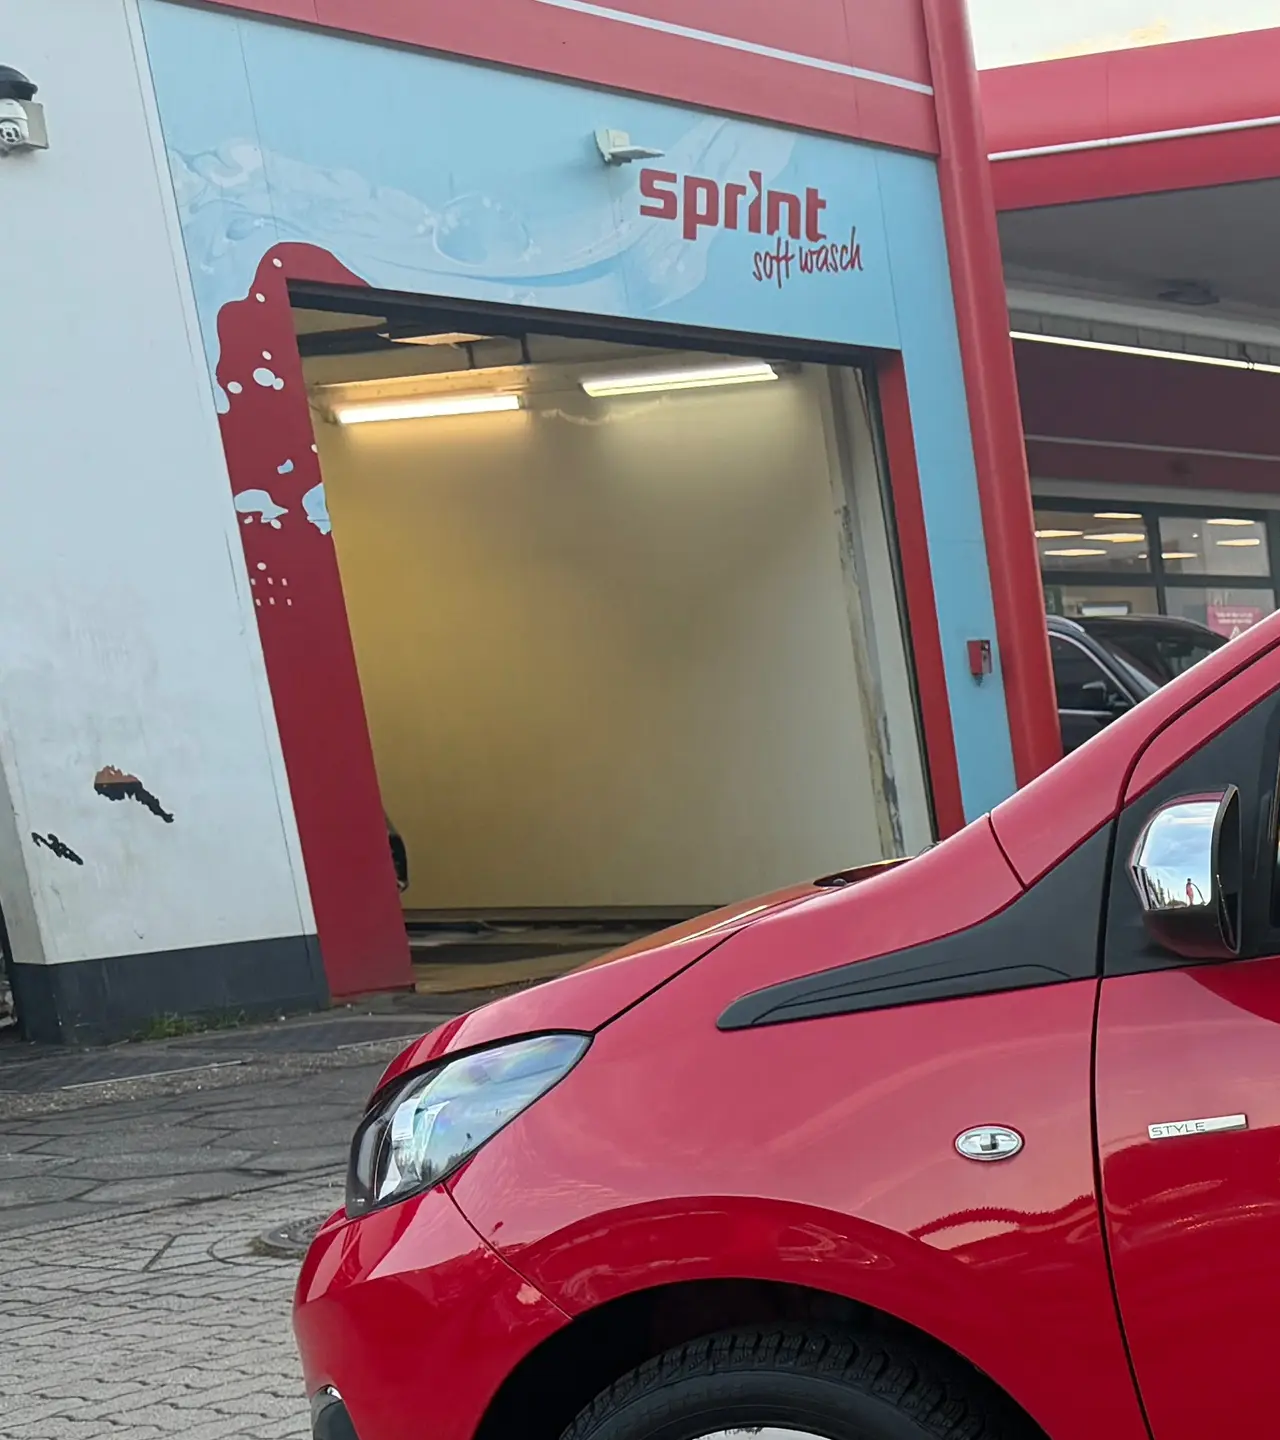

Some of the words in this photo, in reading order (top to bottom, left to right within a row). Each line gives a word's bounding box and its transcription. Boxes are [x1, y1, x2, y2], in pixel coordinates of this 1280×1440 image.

[640, 168, 827, 242] sprint
[753, 236, 795, 289] soft
[800, 226, 863, 273] wasch
[1151, 1122, 1206, 1137] STYLE
